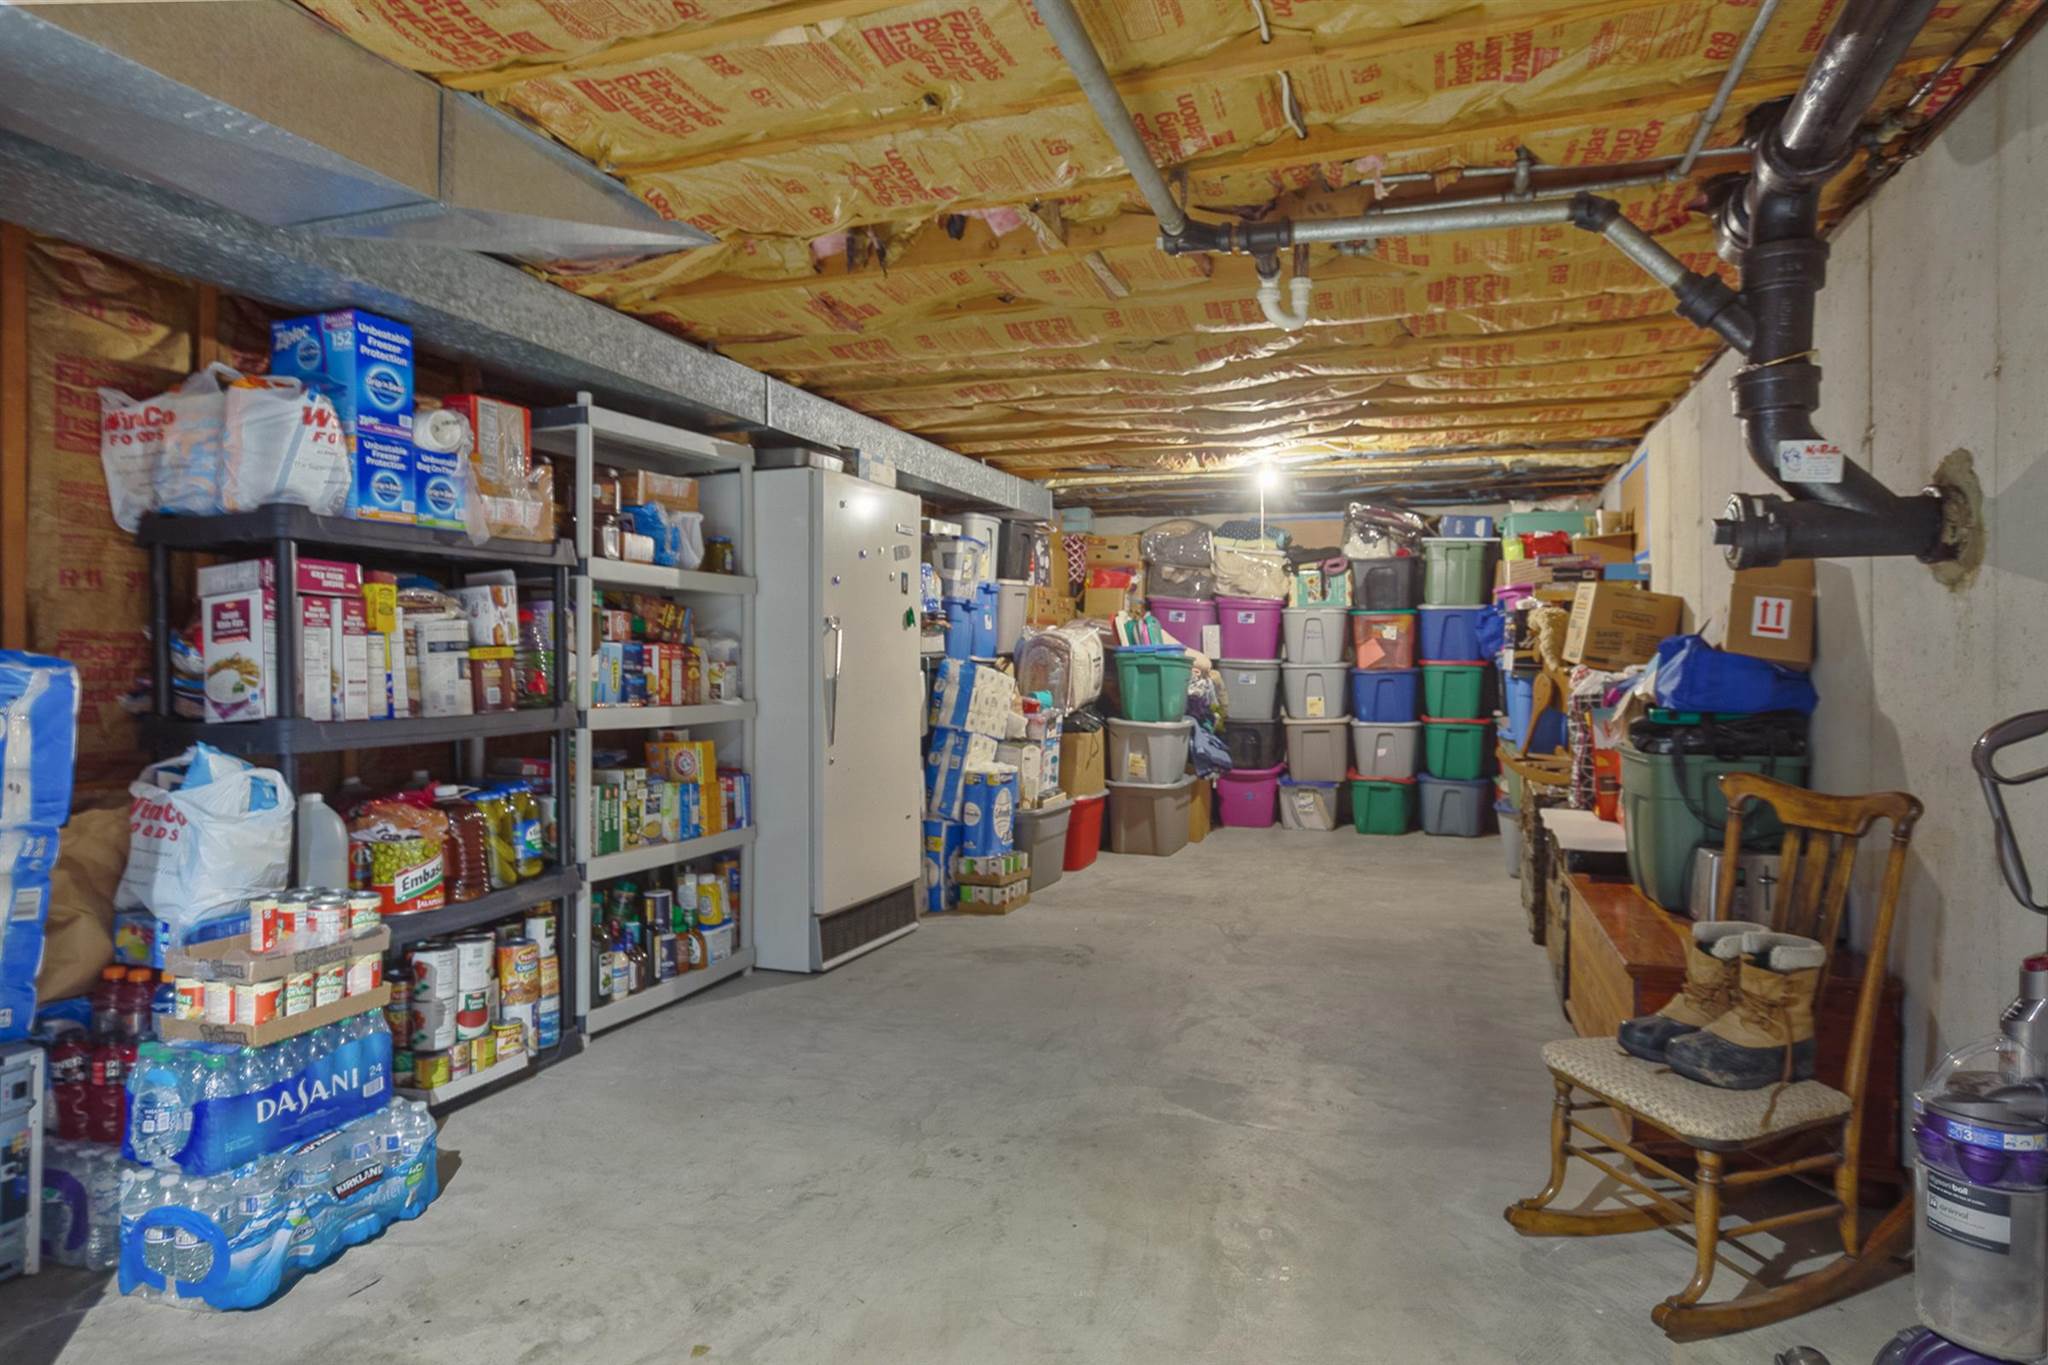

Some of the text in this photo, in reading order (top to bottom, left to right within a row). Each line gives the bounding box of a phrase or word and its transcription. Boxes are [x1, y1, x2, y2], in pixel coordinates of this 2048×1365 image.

[331, 331, 352, 347] 152
[357, 321, 410, 347] Unbeatable
[367, 336, 402, 353] Freezer
[360, 344, 408, 367] Protection
[363, 440, 408, 456] Unbeatable
[371, 450, 401, 462] Freezer
[365, 457, 408, 471] Protection
[369, 1063, 382, 1076] 24
[256, 1067, 358, 1124] DASANI
[1963, 1129, 1973, 1141] 3
[336, 1164, 384, 1193] KIRKLAND
[1951, 1182, 1969, 1196] ball
